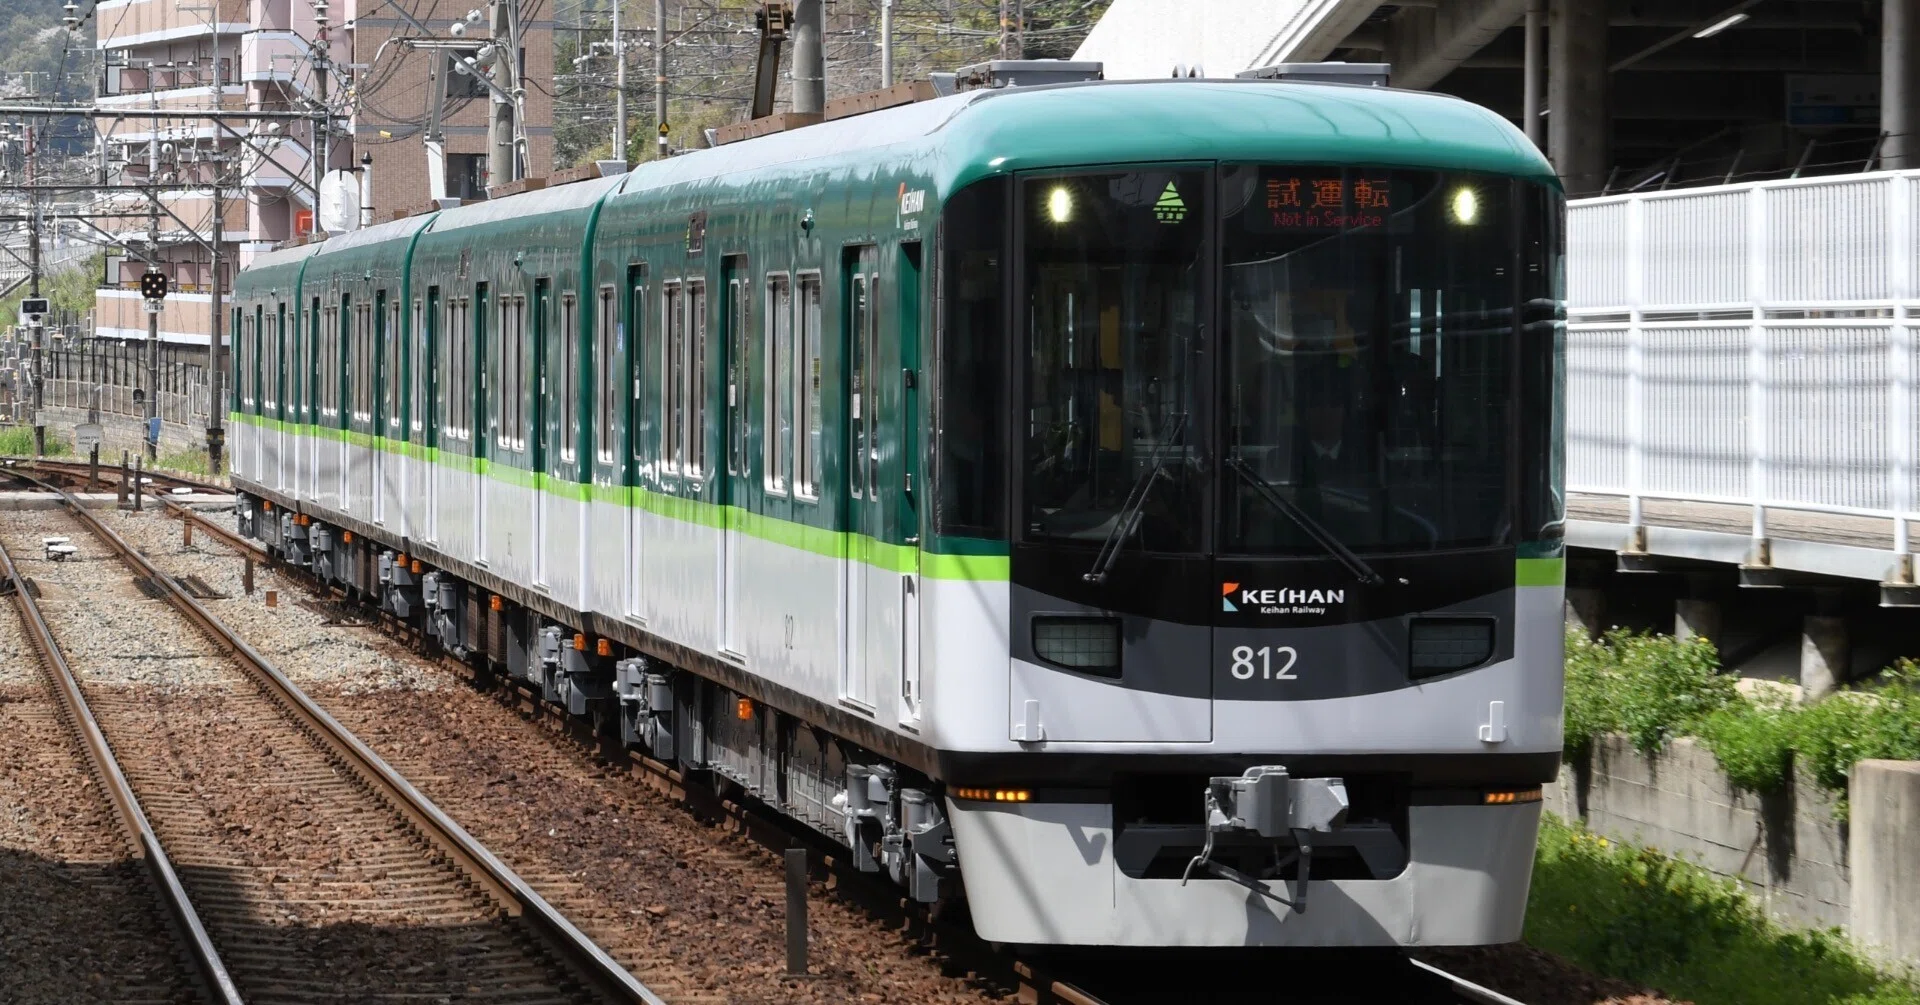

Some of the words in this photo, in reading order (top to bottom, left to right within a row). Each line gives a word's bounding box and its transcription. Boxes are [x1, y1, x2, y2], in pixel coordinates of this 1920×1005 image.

[901, 188, 925, 215] KEIHAN
[1267, 178, 1389, 208] 試運転
[1273, 211, 1301, 226] Not
[1306, 211, 1319, 226] in
[1324, 210, 1381, 226] Service
[1242, 588, 1345, 604] KEIHAN
[1260, 606, 1290, 614] Keihan
[1292, 606, 1325, 615] Railway
[1231, 645, 1298, 680] 812
